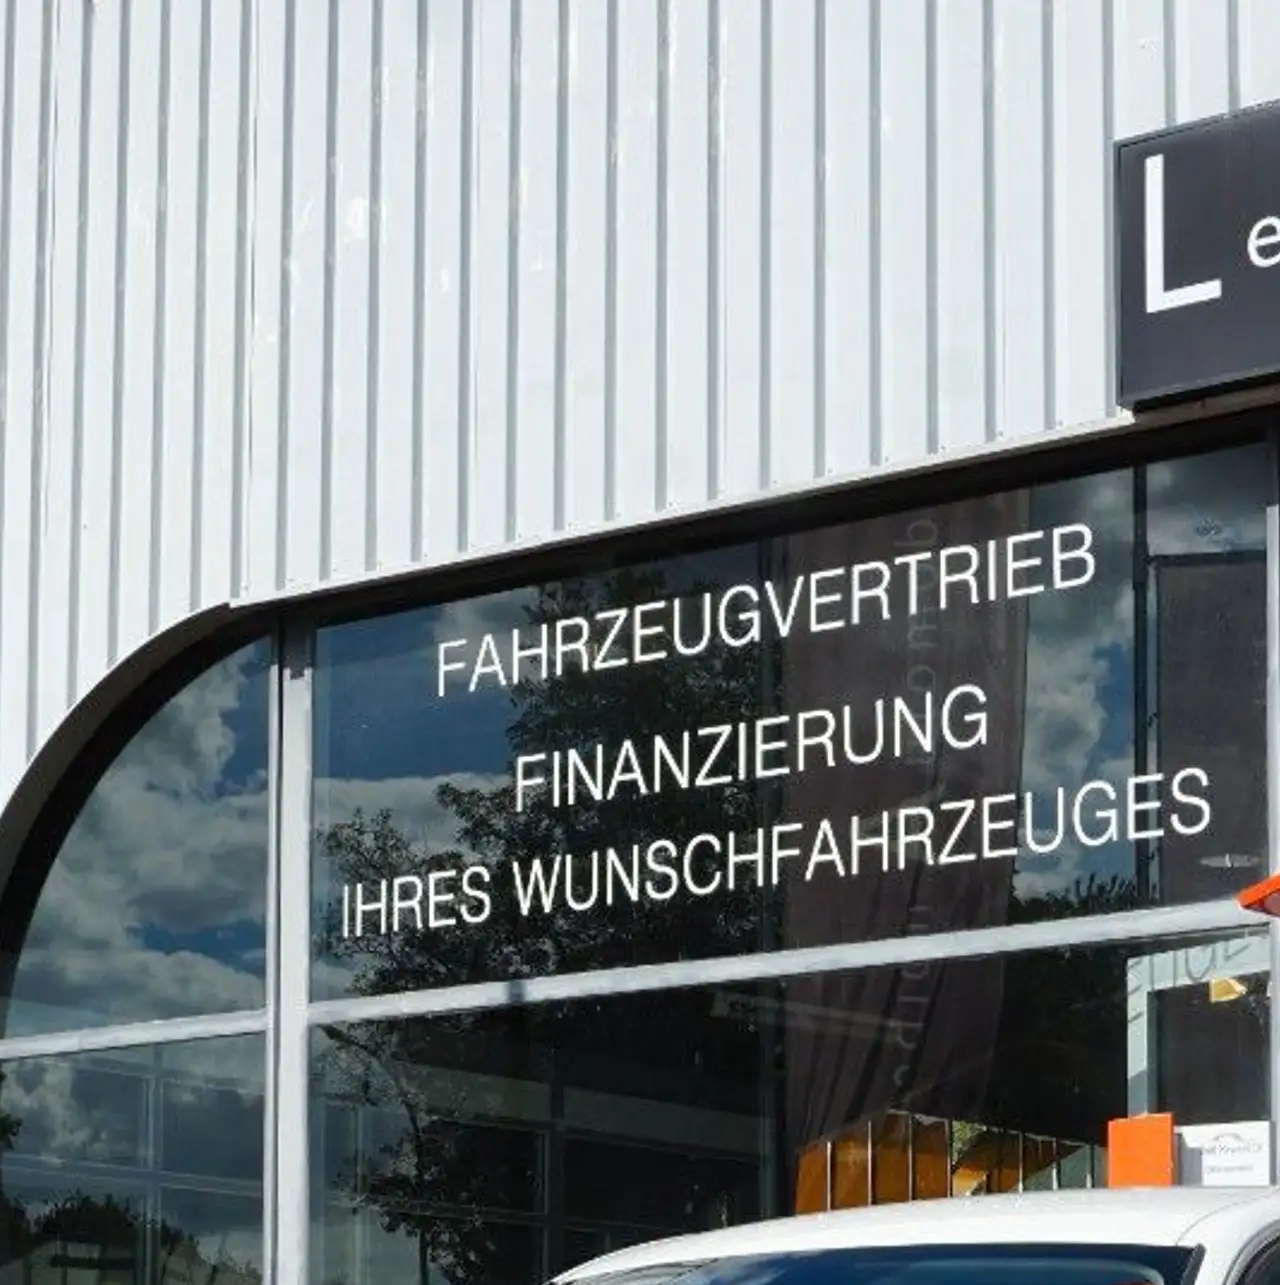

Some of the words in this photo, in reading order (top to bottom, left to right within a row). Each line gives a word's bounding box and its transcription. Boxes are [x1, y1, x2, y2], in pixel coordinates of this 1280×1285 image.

[437, 523, 1096, 698] FAHRZEUGVERTRIEB
[515, 684, 990, 813] FINANZIERUNG
[342, 866, 491, 938] IHRES
[513, 767, 1213, 917] WUNSCHFAHRZEUGES
